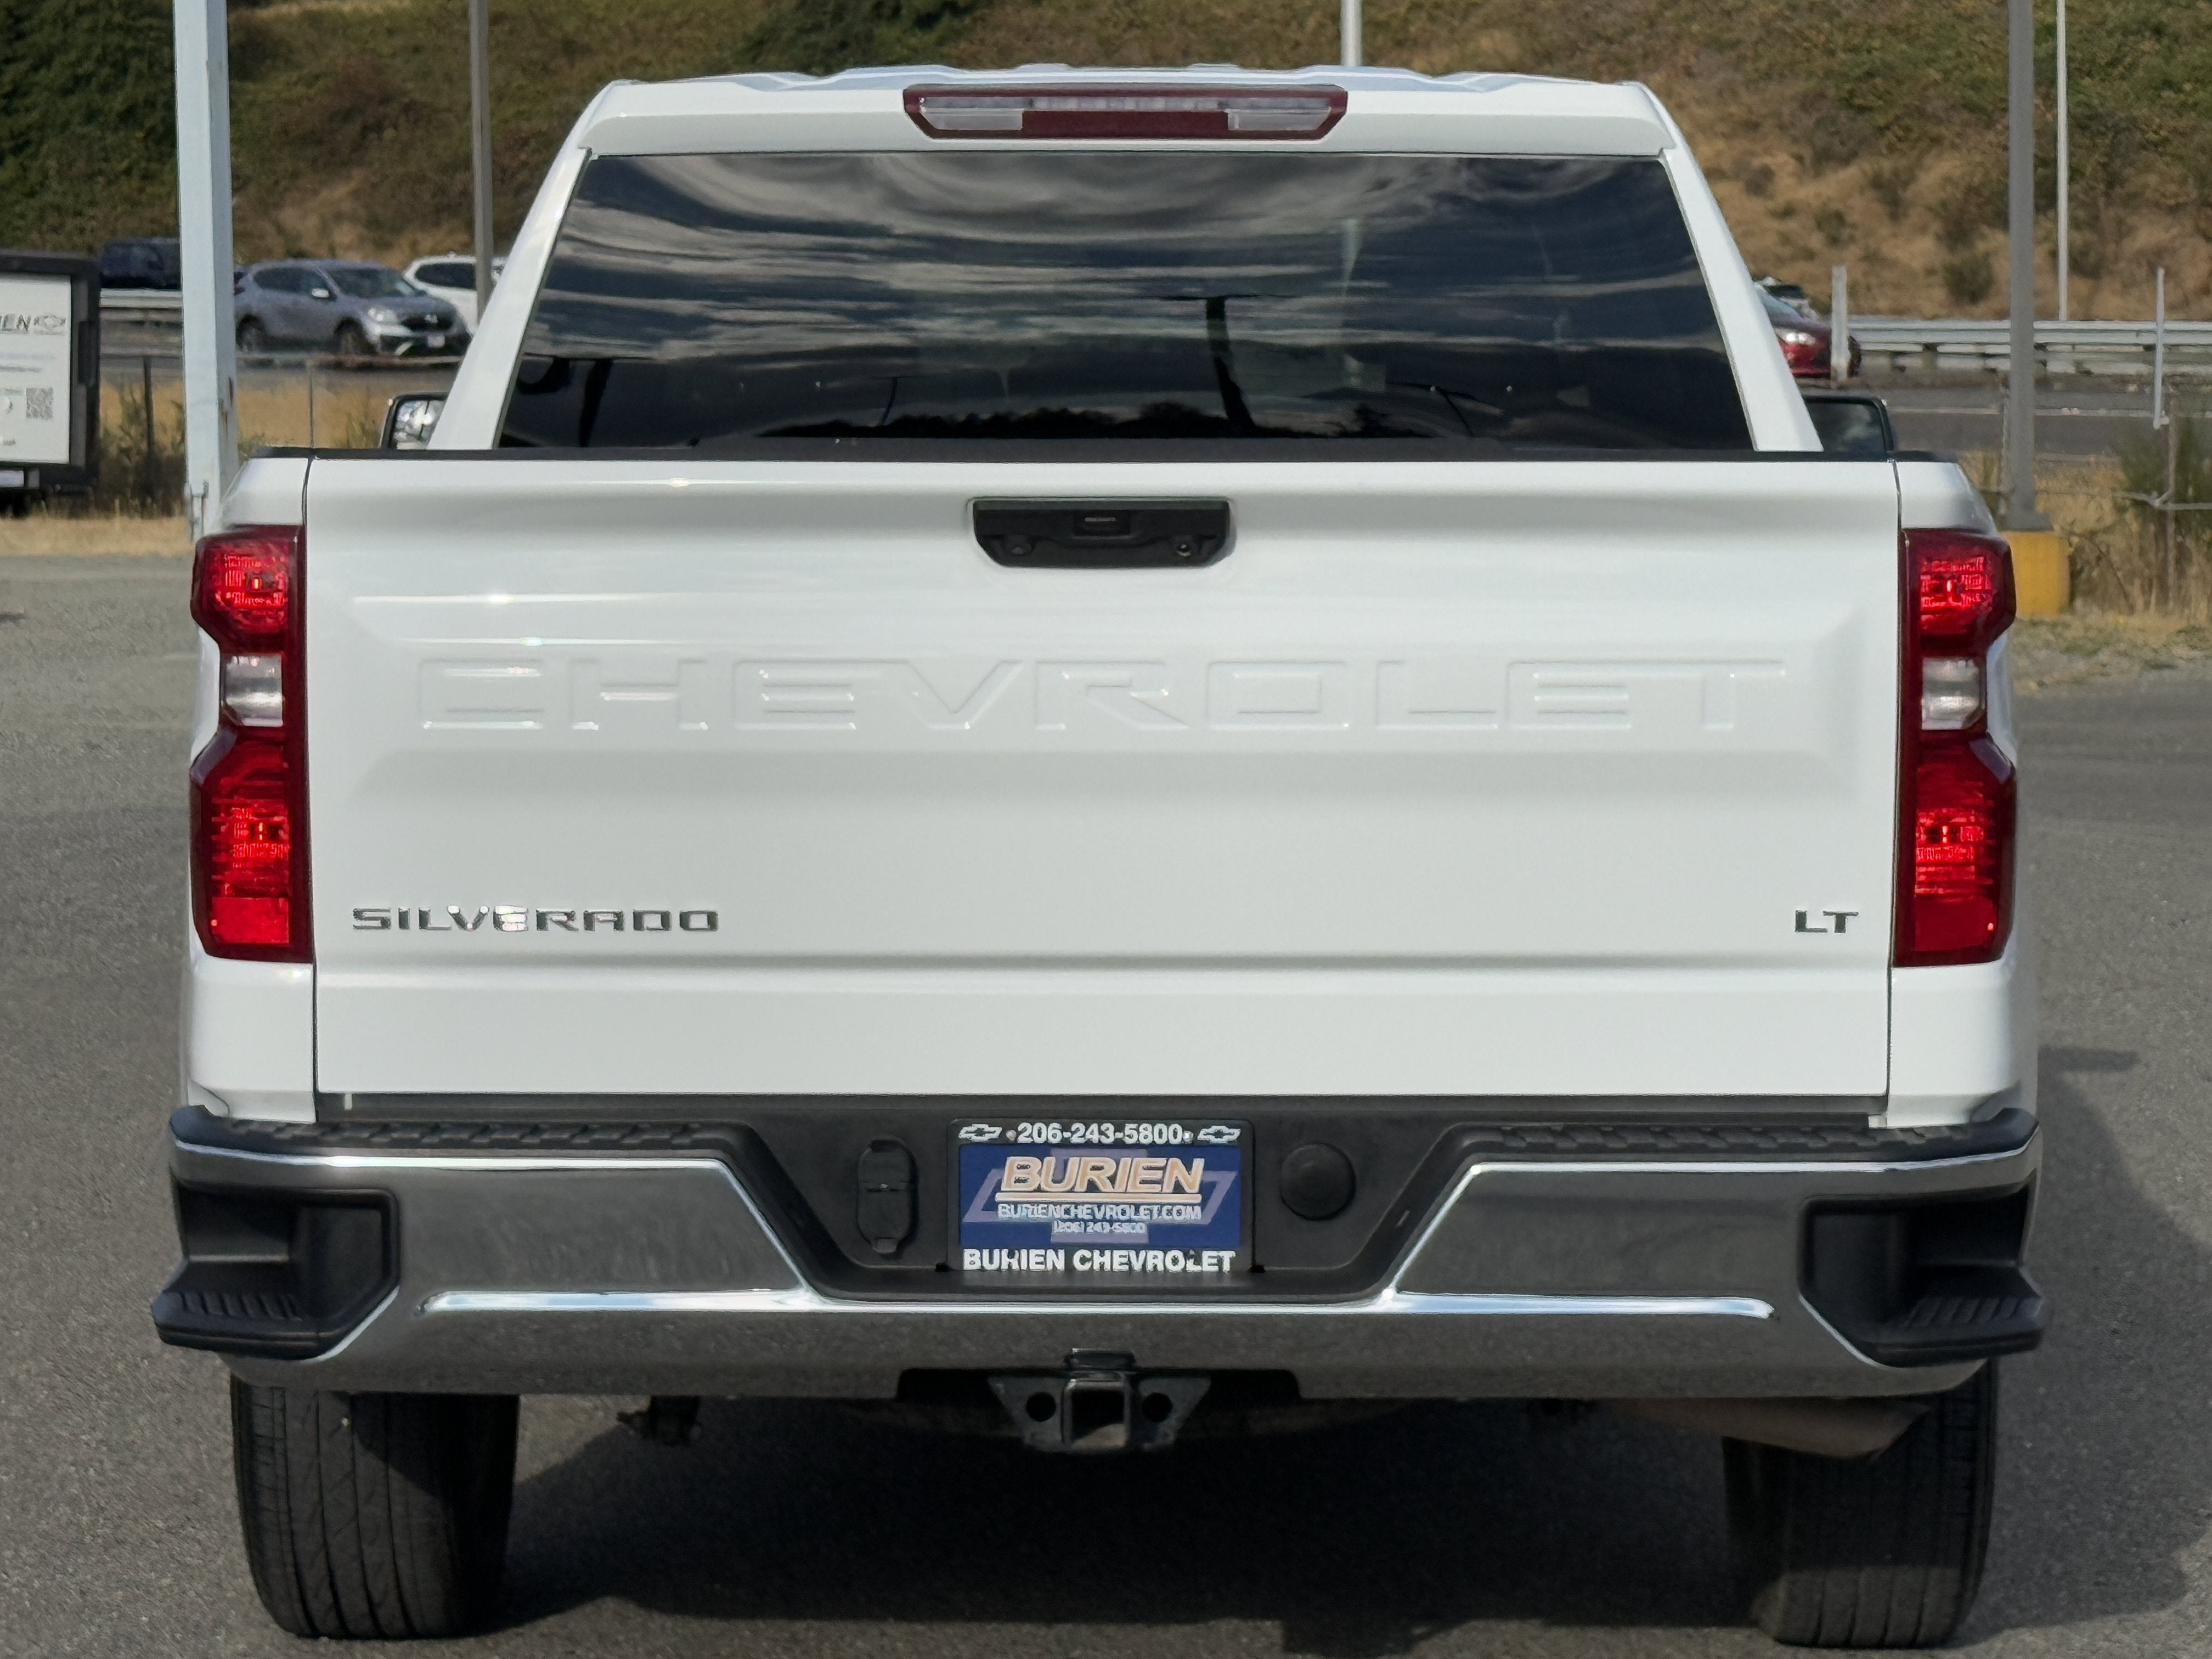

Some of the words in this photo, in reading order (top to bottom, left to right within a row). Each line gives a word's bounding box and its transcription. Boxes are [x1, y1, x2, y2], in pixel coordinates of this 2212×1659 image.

[416, 658, 1787, 733] CHEVROLET
[353, 905, 719, 932] SILVERADO
[1795, 910, 1859, 933] LT
[1017, 1122, 1183, 1144] 206-243-5800
[1000, 1156, 1205, 1193] BURIEN
[997, 1204, 1202, 1220] BURIENCHEVROLET.COM
[1073, 1250, 1237, 1273] CHEVROLET
